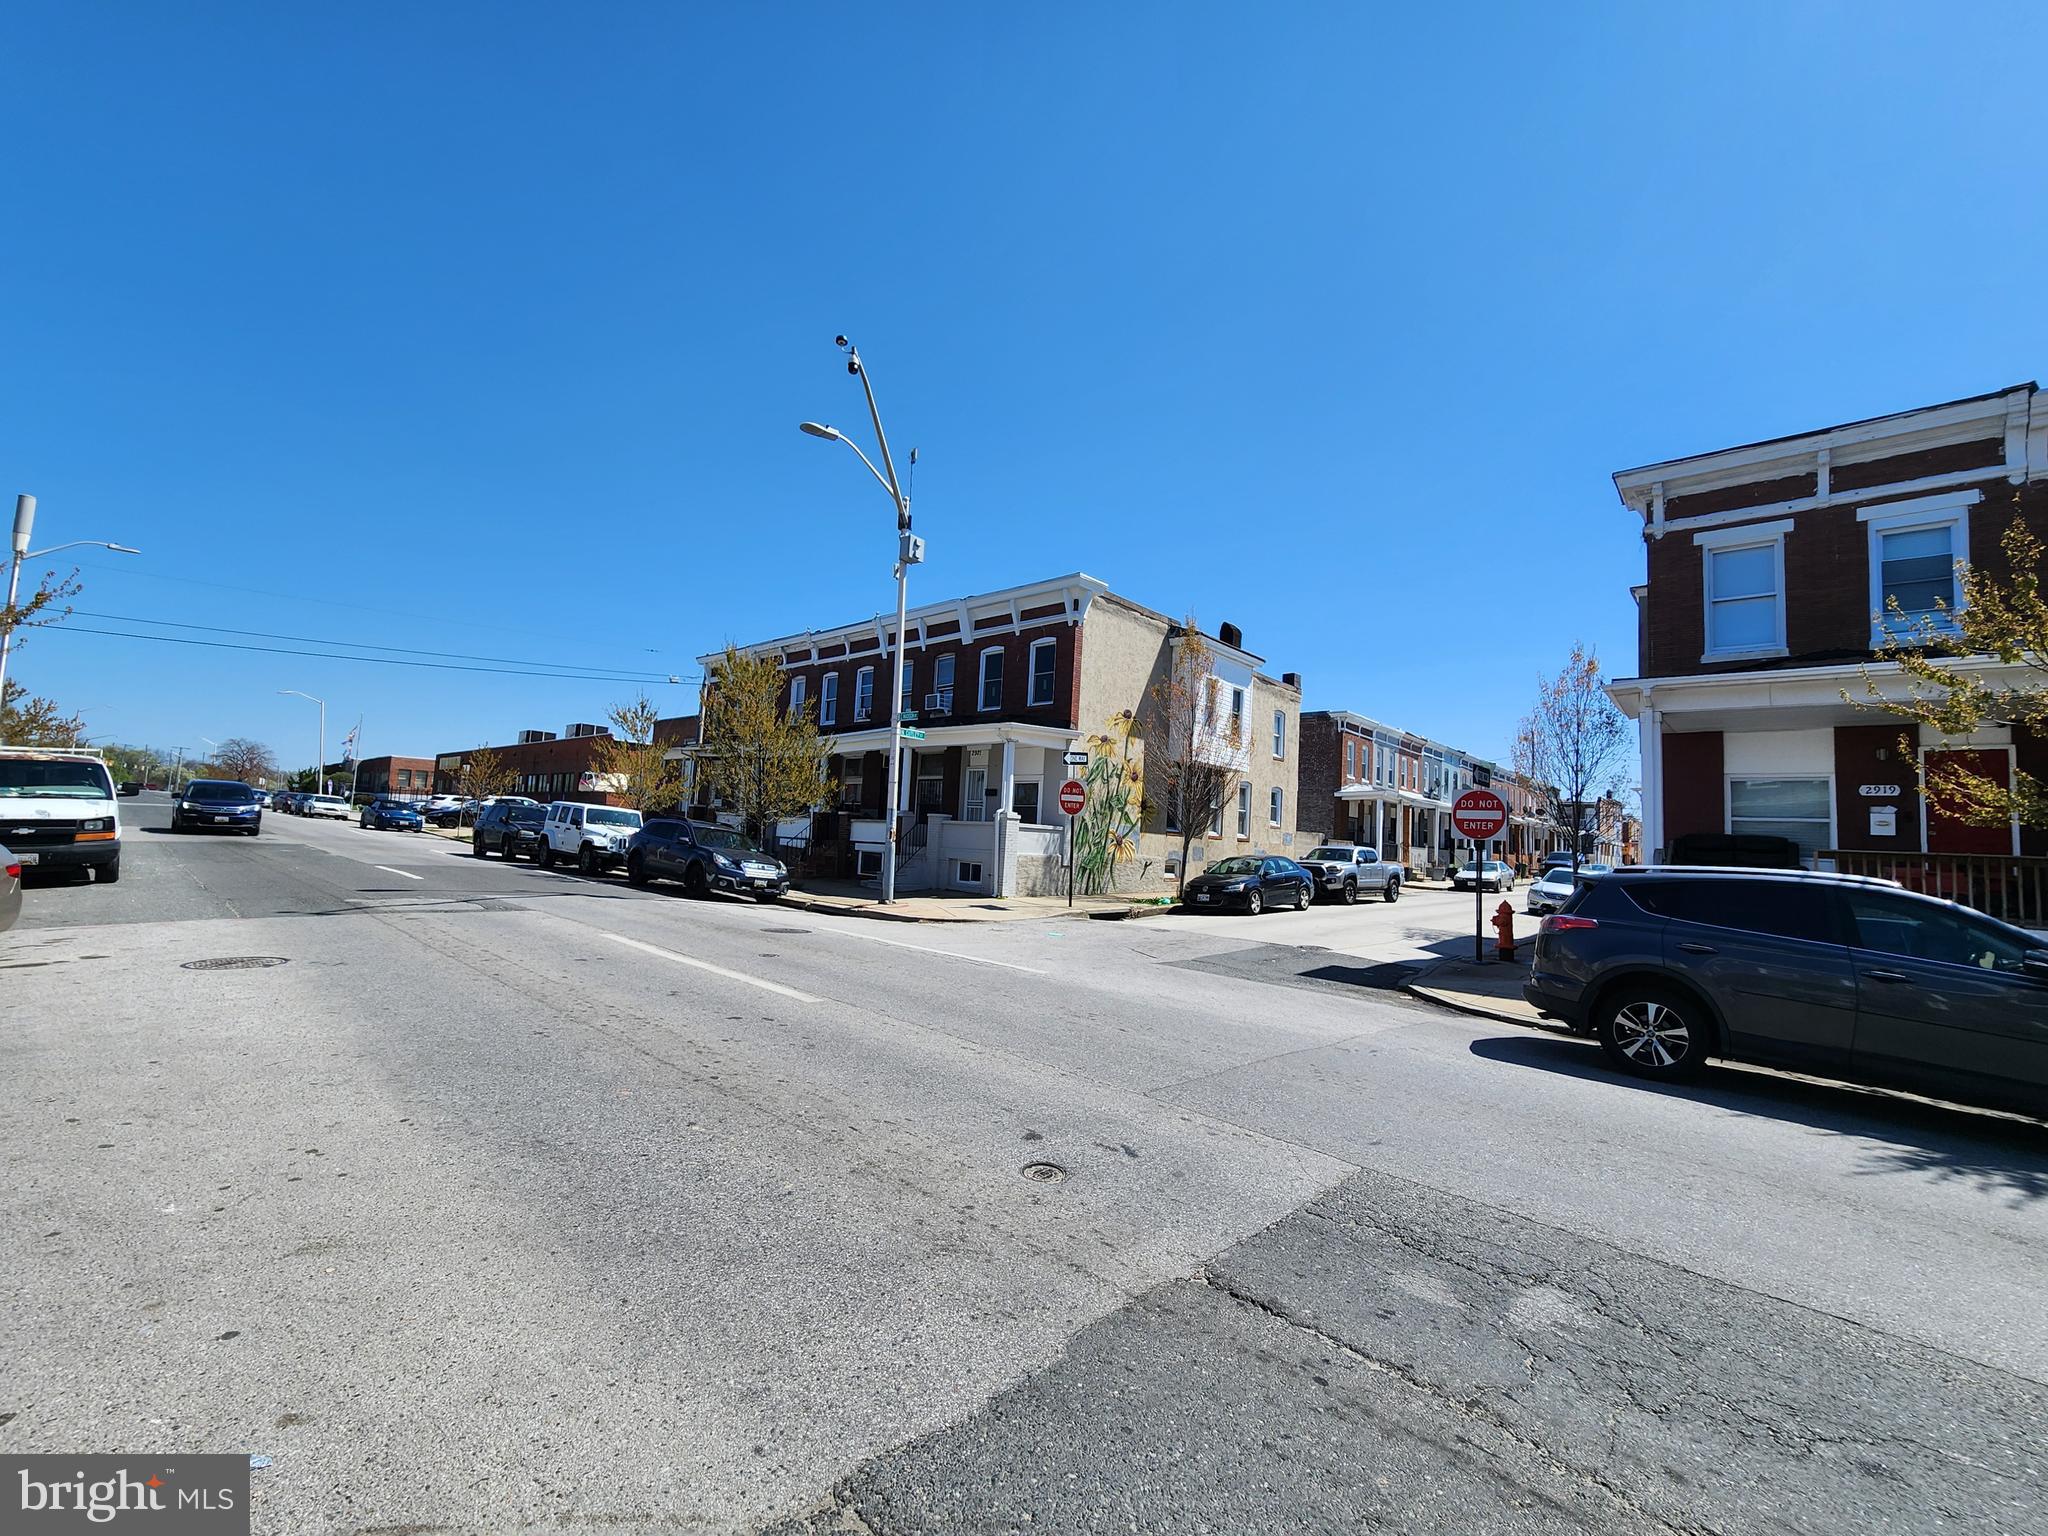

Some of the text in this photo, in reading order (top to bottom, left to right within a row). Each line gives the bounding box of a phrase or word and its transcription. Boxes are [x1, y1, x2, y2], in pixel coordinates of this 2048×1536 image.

[1865, 786, 1896, 794] 2919
[1480, 800, 1498, 808] NOT
[1464, 821, 1494, 829] ENTER
